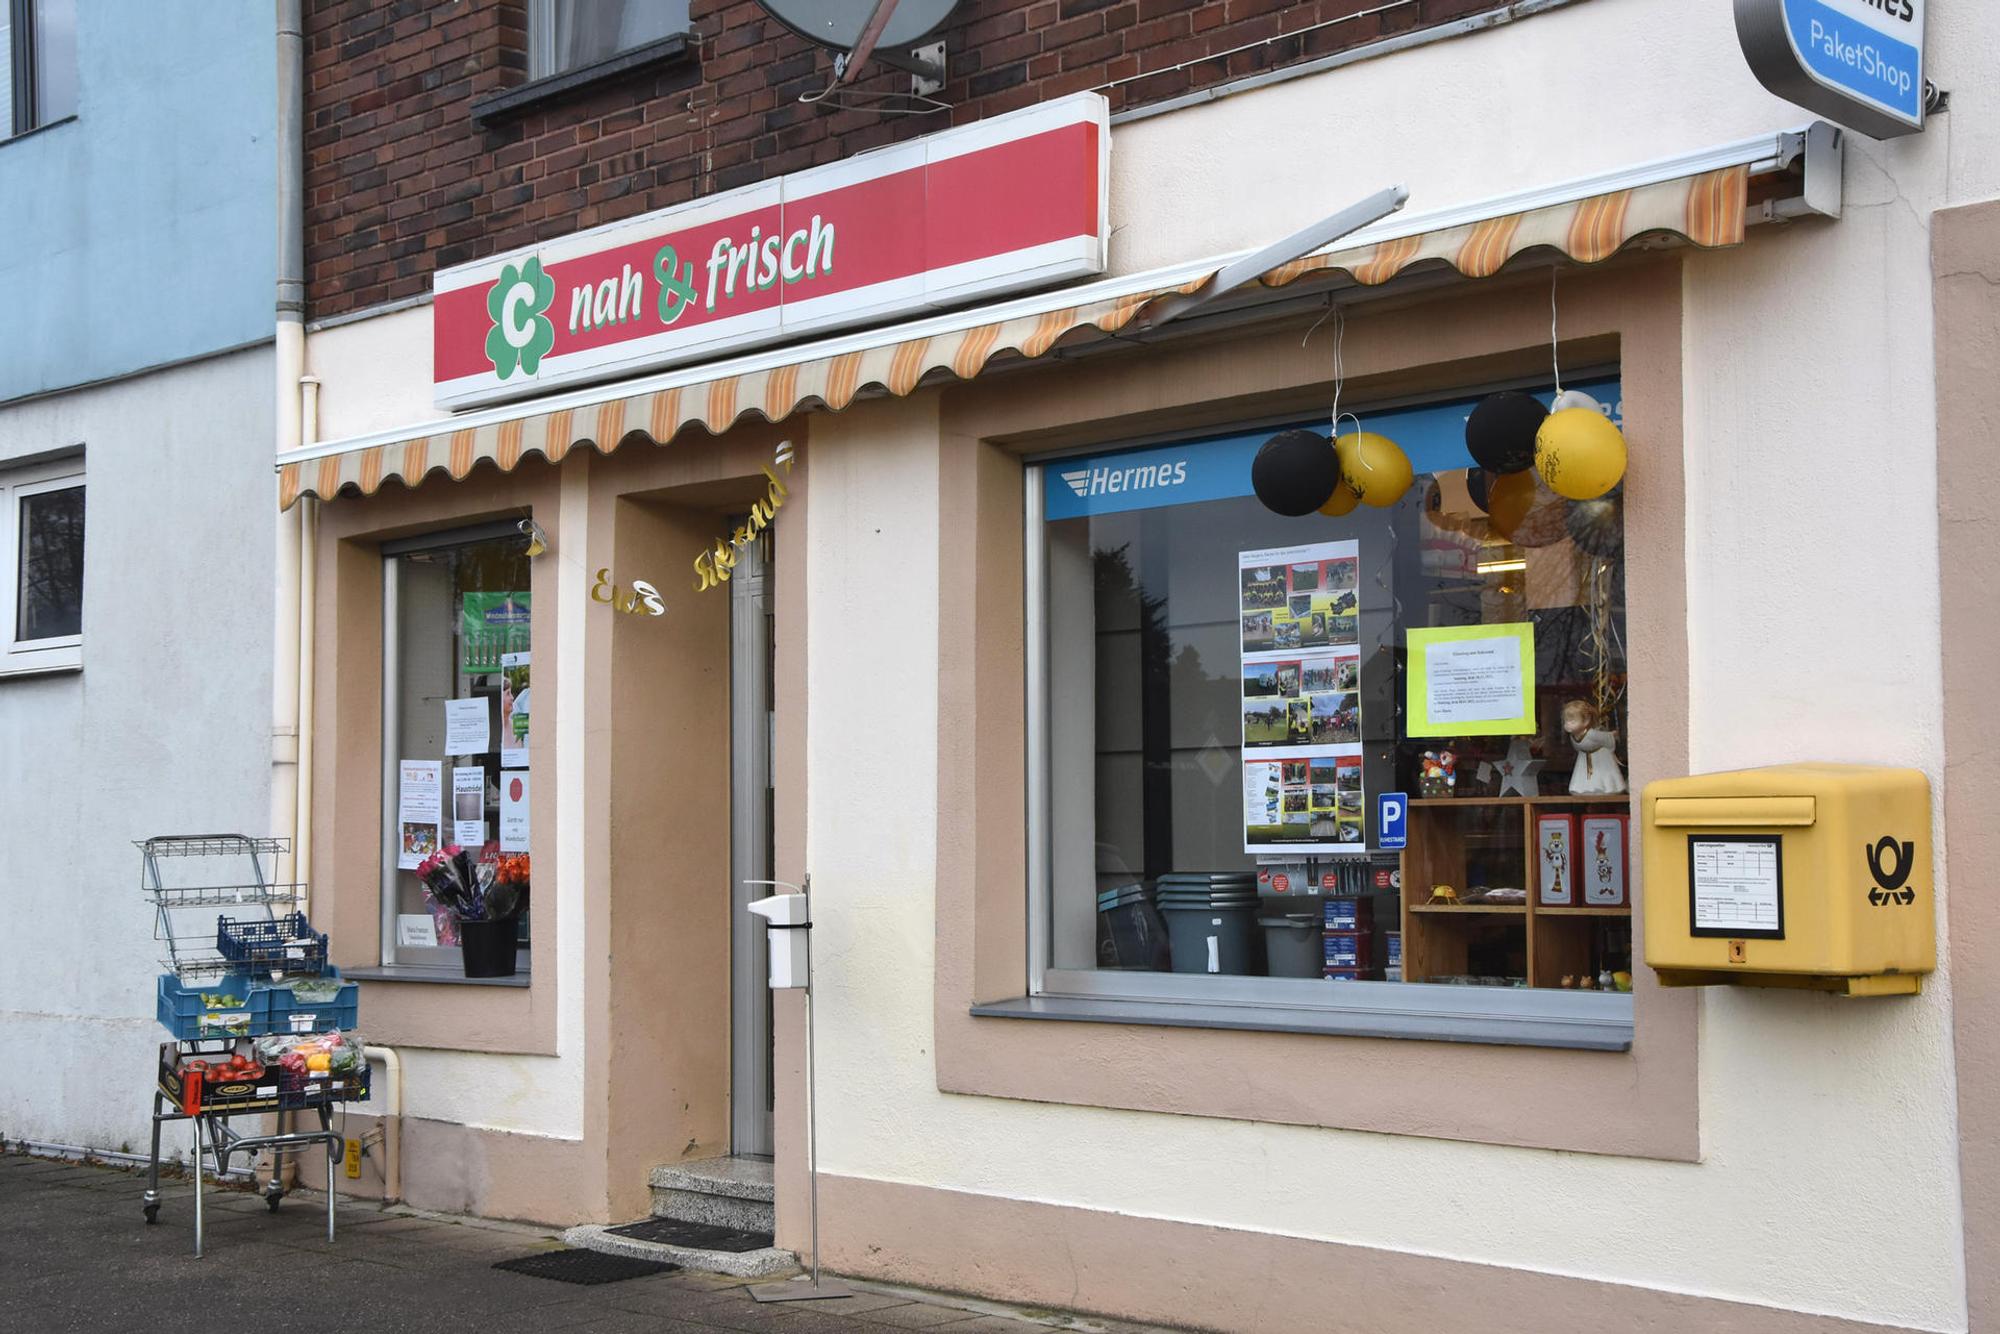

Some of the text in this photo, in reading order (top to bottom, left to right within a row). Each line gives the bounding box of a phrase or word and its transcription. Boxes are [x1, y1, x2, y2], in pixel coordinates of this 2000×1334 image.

[1811, 19, 1911, 96] PaketShop
[569, 264, 643, 335] nah
[653, 245, 698, 325] &
[706, 214, 836, 312] frisch
[1090, 460, 1187, 496] Hermes
[1383, 801, 1401, 834] P
